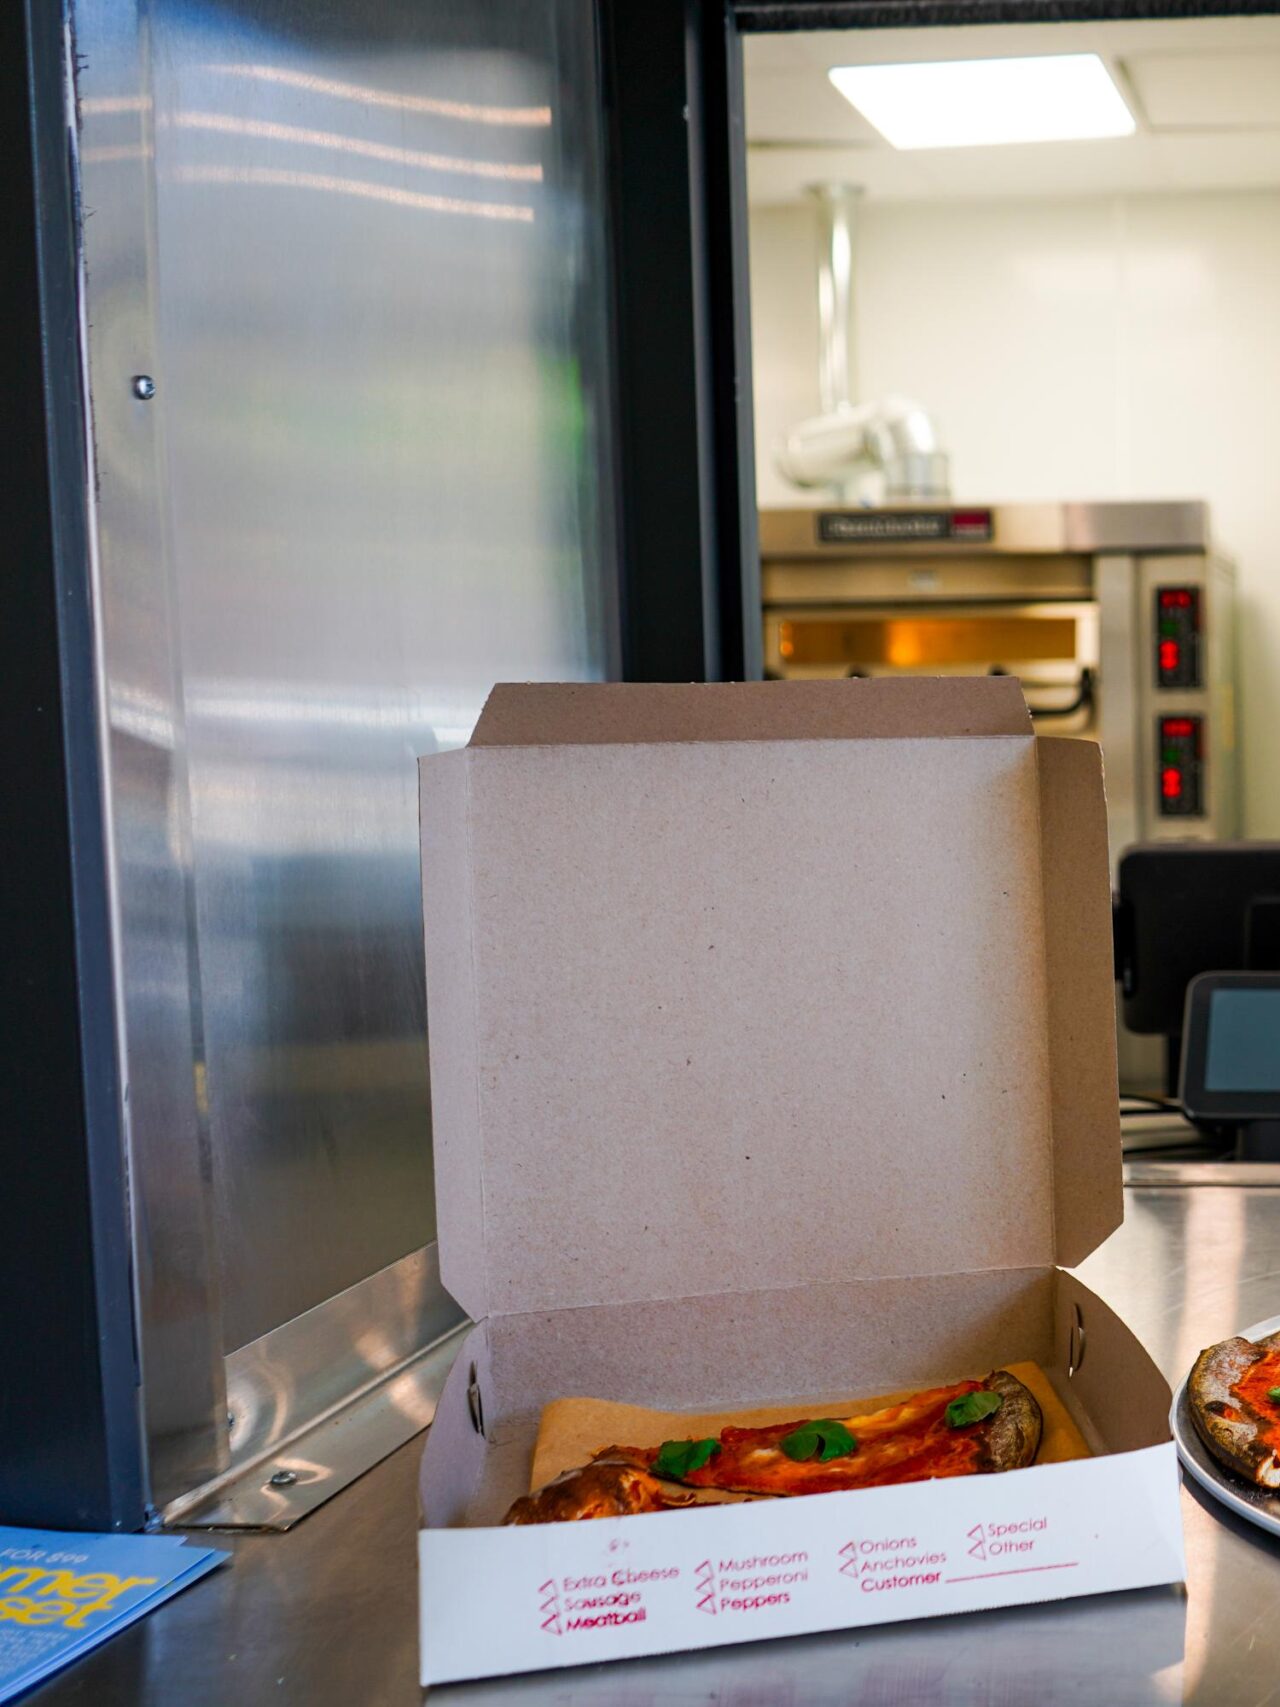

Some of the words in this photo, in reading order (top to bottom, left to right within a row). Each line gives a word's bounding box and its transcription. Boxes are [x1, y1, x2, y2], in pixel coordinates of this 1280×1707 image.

[988, 1517, 1048, 1537] Special
[859, 1536, 918, 1555] Onions
[989, 1539, 1035, 1556] Other
[718, 1550, 809, 1573] Mushroom
[860, 1551, 947, 1573] Anchovies
[562, 1575, 607, 1592] Extra
[611, 1566, 681, 1586] Cheese
[719, 1569, 809, 1592] Pepperoni
[860, 1570, 942, 1593] Customer
[563, 1591, 642, 1612] Sausage
[719, 1591, 790, 1612] Peppers
[566, 1606, 647, 1631] Meatball
